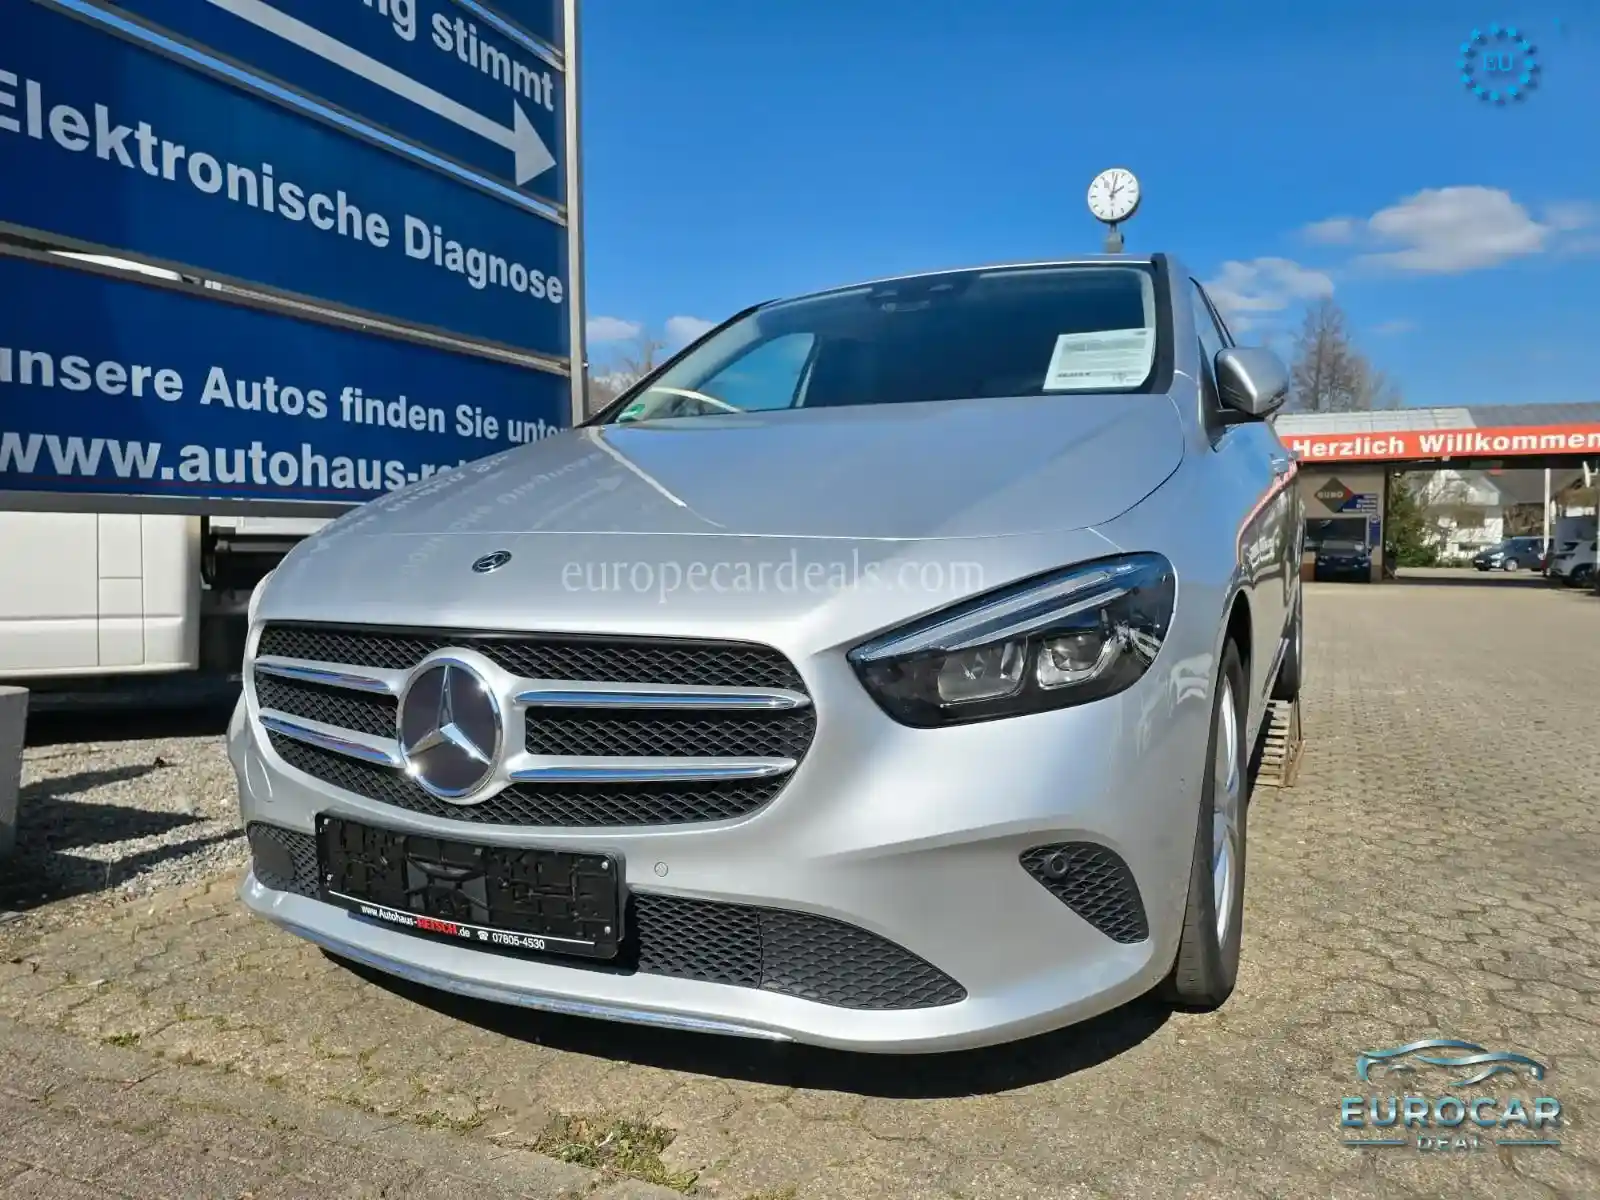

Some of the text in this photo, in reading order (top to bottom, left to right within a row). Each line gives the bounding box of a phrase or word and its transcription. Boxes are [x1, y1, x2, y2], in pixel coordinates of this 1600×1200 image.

[431, 12, 554, 112] stimmt
[404, 214, 564, 302] Diagnose
[200, 366, 328, 419] Autos
[339, 386, 446, 433] finden
[455, 404, 499, 440] Sie
[507, 418, 568, 443] unt
[0, 431, 467, 492] www.autohaus-r
[1292, 432, 1600, 458] Herzlich Willkommen
[492, 932, 546, 950] 07805-4530
